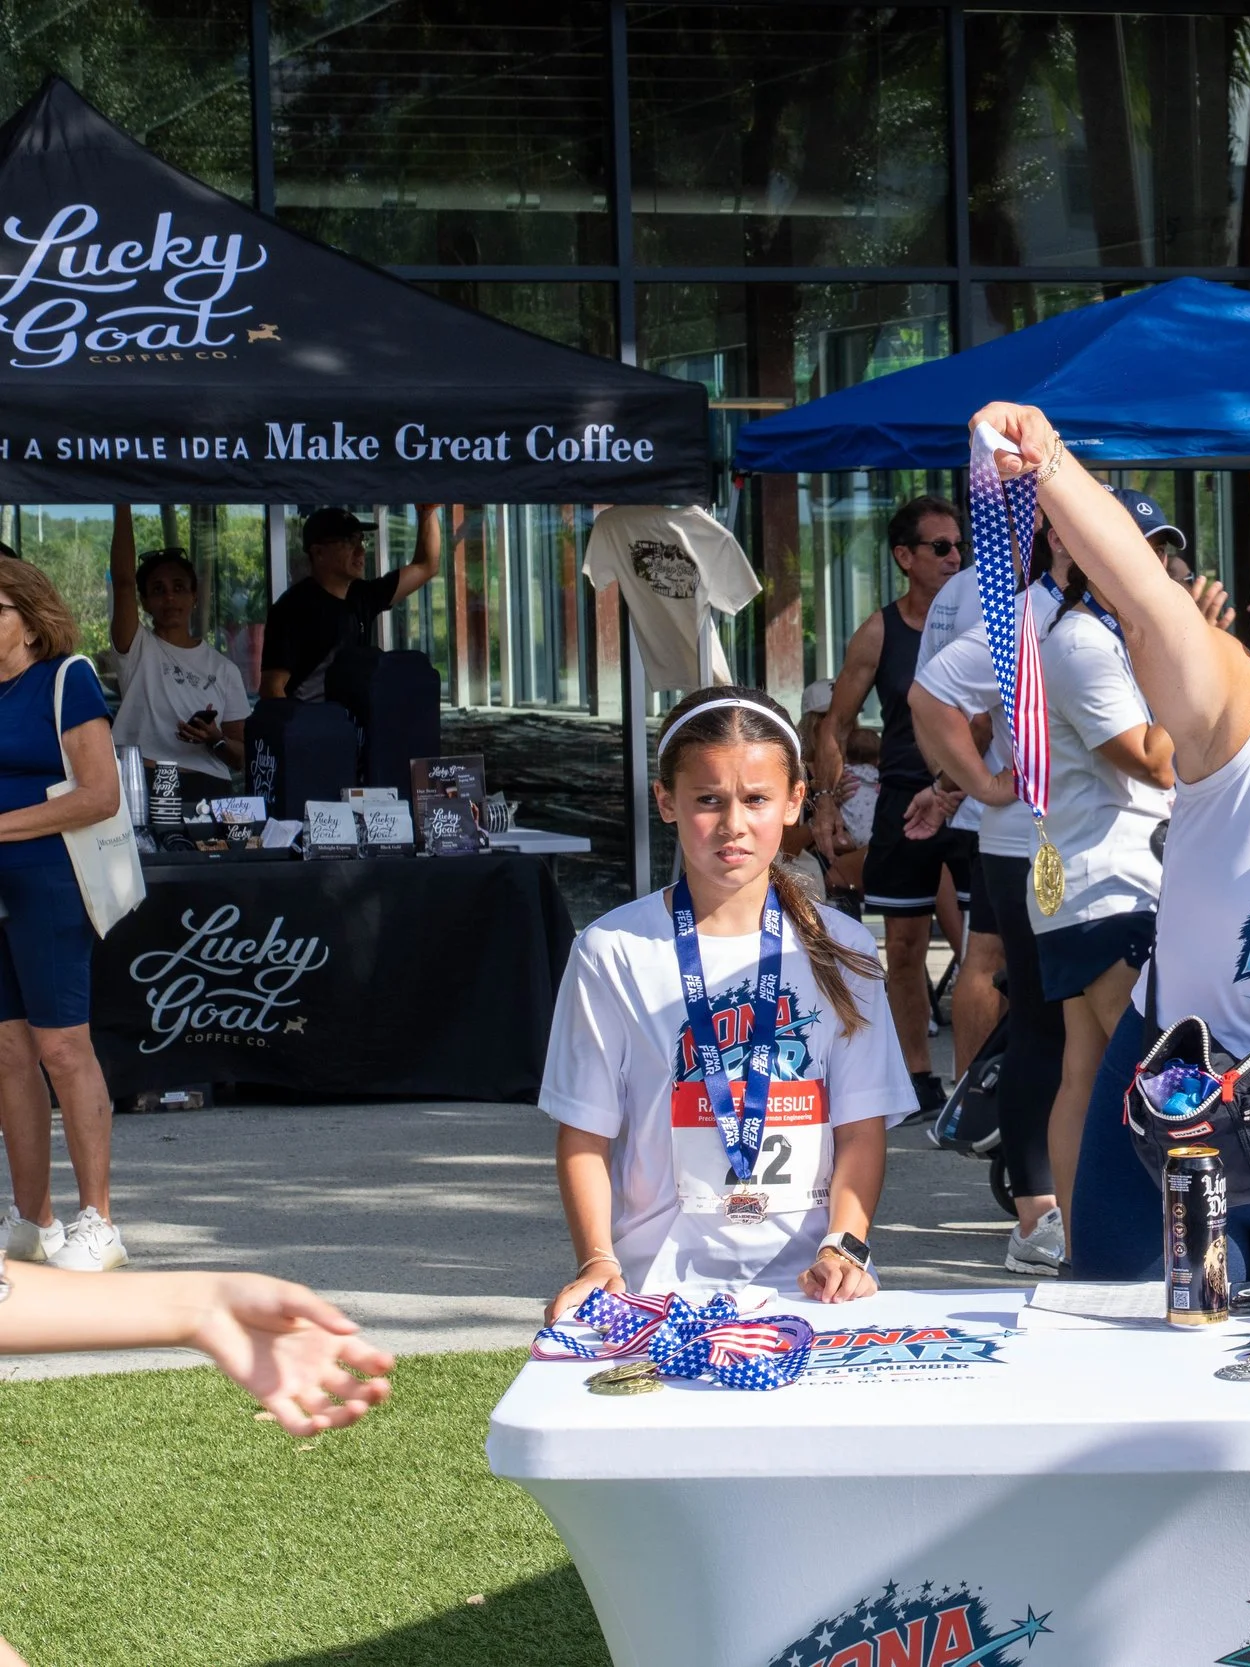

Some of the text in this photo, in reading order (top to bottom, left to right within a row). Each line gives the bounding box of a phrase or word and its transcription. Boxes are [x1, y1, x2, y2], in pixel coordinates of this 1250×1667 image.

[0, 204, 267, 305] Lucky
[0, 298, 253, 368] Goat
[88, 351, 237, 364] COFFEE CO.
[24, 438, 42, 459] A
[57, 437, 168, 460] SIMPLE
[180, 437, 249, 460] IDEA
[264, 421, 380, 462] Make
[395, 422, 512, 462] Great
[526, 422, 655, 463] Coffee
[313, 811, 341, 830] Lucky
[368, 811, 398, 829] Lucky
[429, 808, 461, 826] Lucky
[227, 825, 252, 840] Lucky
[368, 825, 394, 843] Goat
[432, 822, 460, 839] Goat
[675, 910, 687, 937] FEAR
[684, 909, 694, 934] NONA
[765, 909, 774, 933] NONA
[771, 910, 781, 937] FEAR
[129, 904, 329, 993] Lucky
[683, 974, 698, 1003] FEAR
[692, 975, 704, 1000] NONA
[760, 974, 768, 999] NONA
[766, 973, 778, 1004] FEAR
[139, 975, 301, 1054] Goat
[185, 1033, 271, 1048] COFFEE CO.
[698, 1044, 715, 1075] FEAR
[708, 1045, 722, 1072] NONA
[752, 1045, 762, 1072] NONA
[759, 1044, 771, 1076] FEAR
[698, 1095, 815, 1112] RE RESULT
[727, 1116, 740, 1144] NONA
[783, 1113, 813, 1122] Engineering
[718, 1116, 734, 1148] FEAR
[742, 1118, 753, 1145] NONA
[750, 1117, 762, 1150] FEAR
[1174, 1126, 1208, 1137] HUNTER
[811, 1329, 957, 1349] ONA
[807, 1342, 998, 1367] EAR
[848, 1363, 970, 1373] REMEMBER
